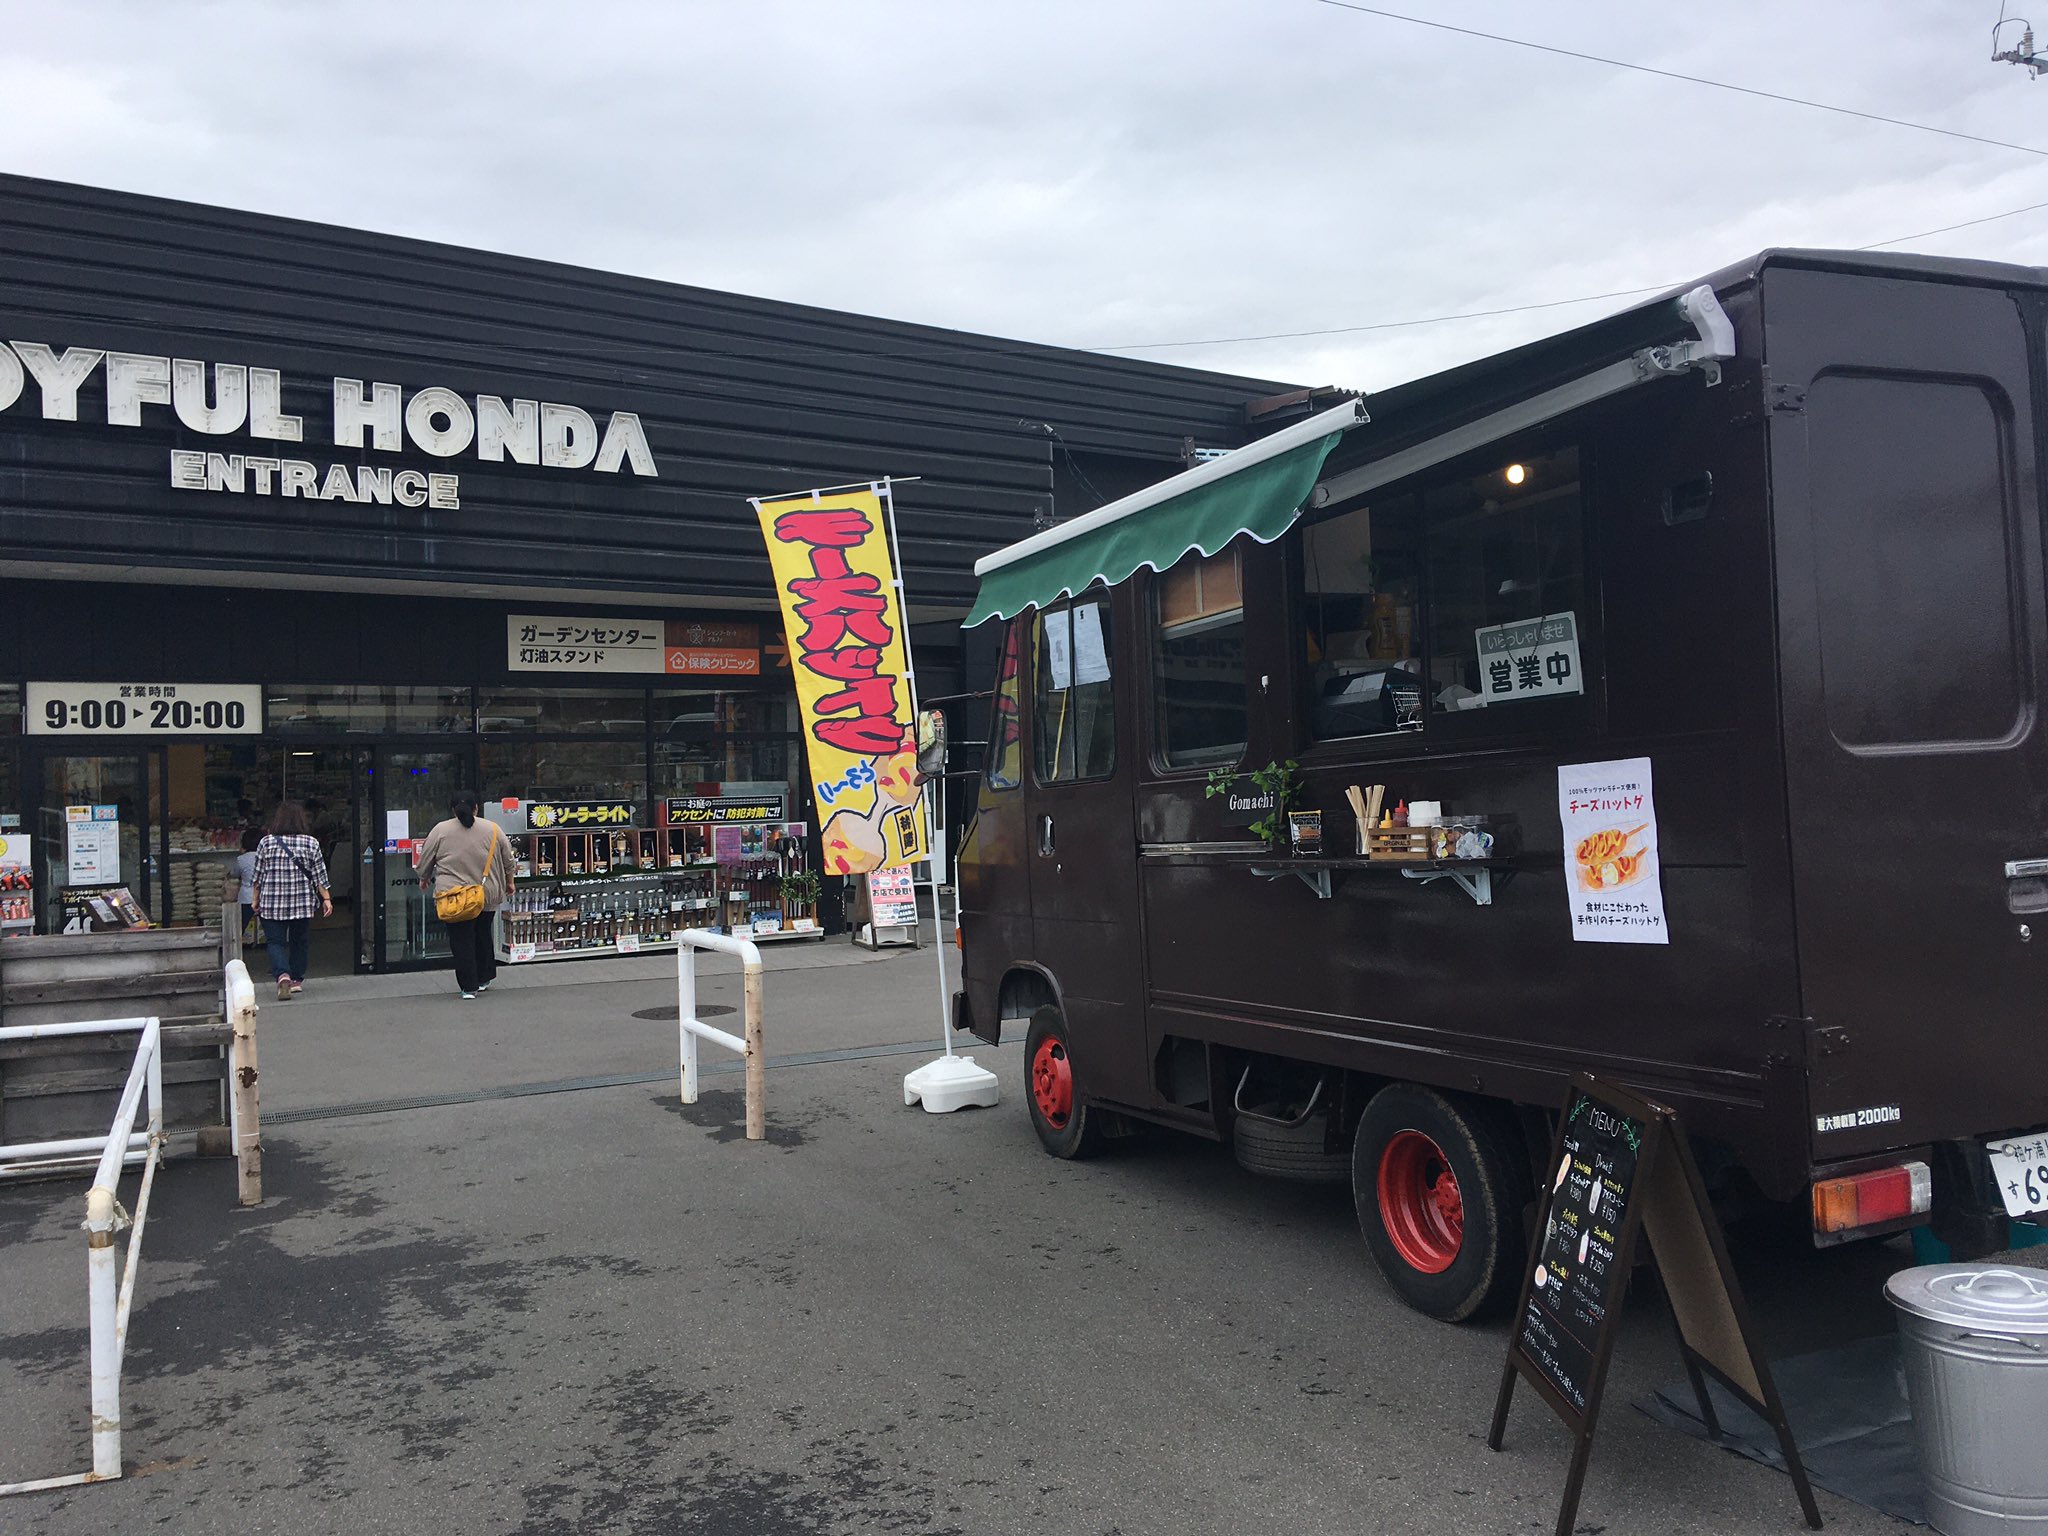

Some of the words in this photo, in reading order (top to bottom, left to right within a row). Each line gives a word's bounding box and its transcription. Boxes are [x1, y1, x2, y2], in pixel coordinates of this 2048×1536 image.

[333, 377, 659, 477] HONDA
[170, 449, 460, 510] ENTRANCE
[520, 625, 657, 645] ガーデンセンター
[1487, 623, 1565, 650] いらっしゃいませ
[519, 648, 605, 665] 灯油スタンド
[688, 657, 756, 670] 保険クリニック
[1489, 651, 1571, 694] 営業中
[119, 685, 176, 698] 営業時間
[45, 700, 126, 729] 9:00
[150, 700, 245, 730] 20:00
[1229, 791, 1274, 811] Gomachi
[1569, 795, 1645, 814] チーズハットグ
[557, 805, 630, 824] ソーラーライト
[391, 876, 421, 888] JOYFU
[1585, 902, 1649, 914] 食材にこだわった
[1577, 915, 1661, 927] 手作りのチーズハットグ
[1589, 1107, 1621, 1137] MENU
[1857, 1106, 1901, 1126] 2000kg
[2007, 1180, 2019, 1199] す
[1602, 1204, 1617, 1224] ¥150
